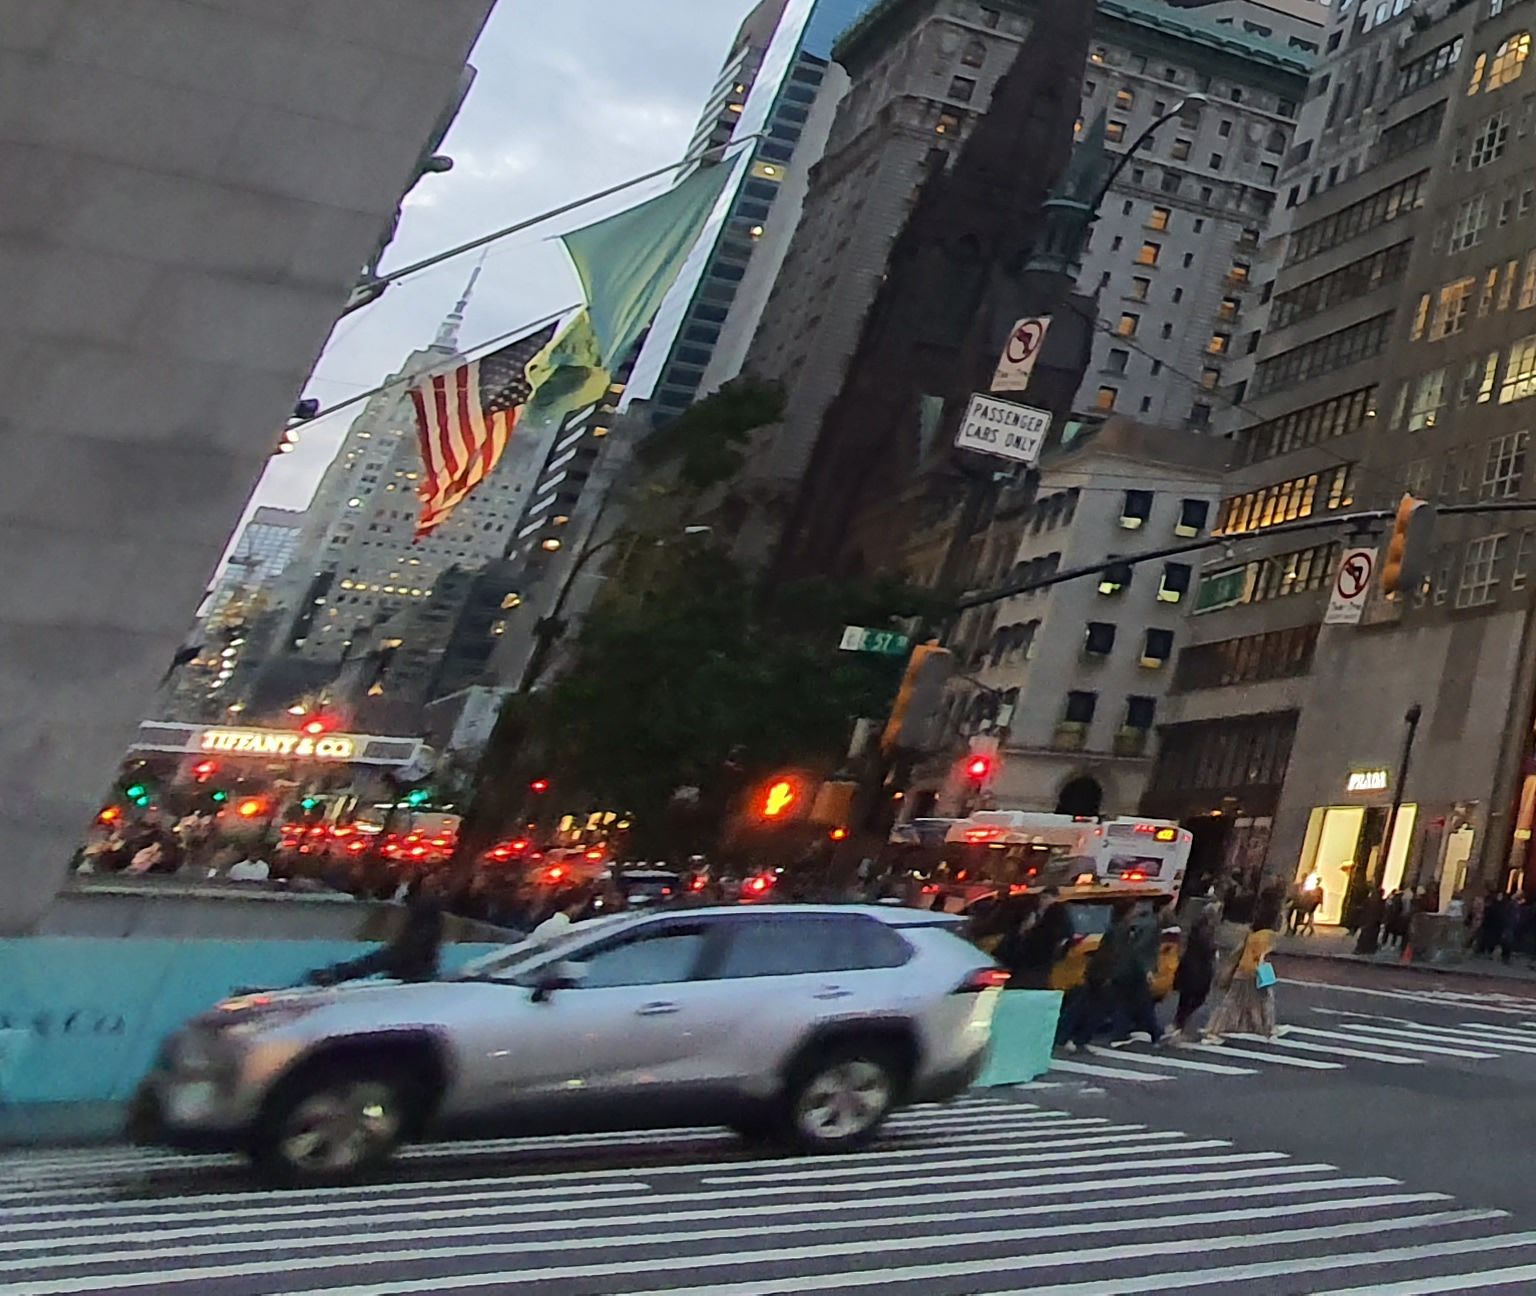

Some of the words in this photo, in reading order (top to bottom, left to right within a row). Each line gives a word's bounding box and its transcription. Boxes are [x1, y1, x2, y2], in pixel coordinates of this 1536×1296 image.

[973, 402, 1043, 433] PASSENGER
[965, 422, 999, 443] CARS
[1004, 433, 1037, 453] ONLY
[201, 730, 297, 755] TIFFANY
